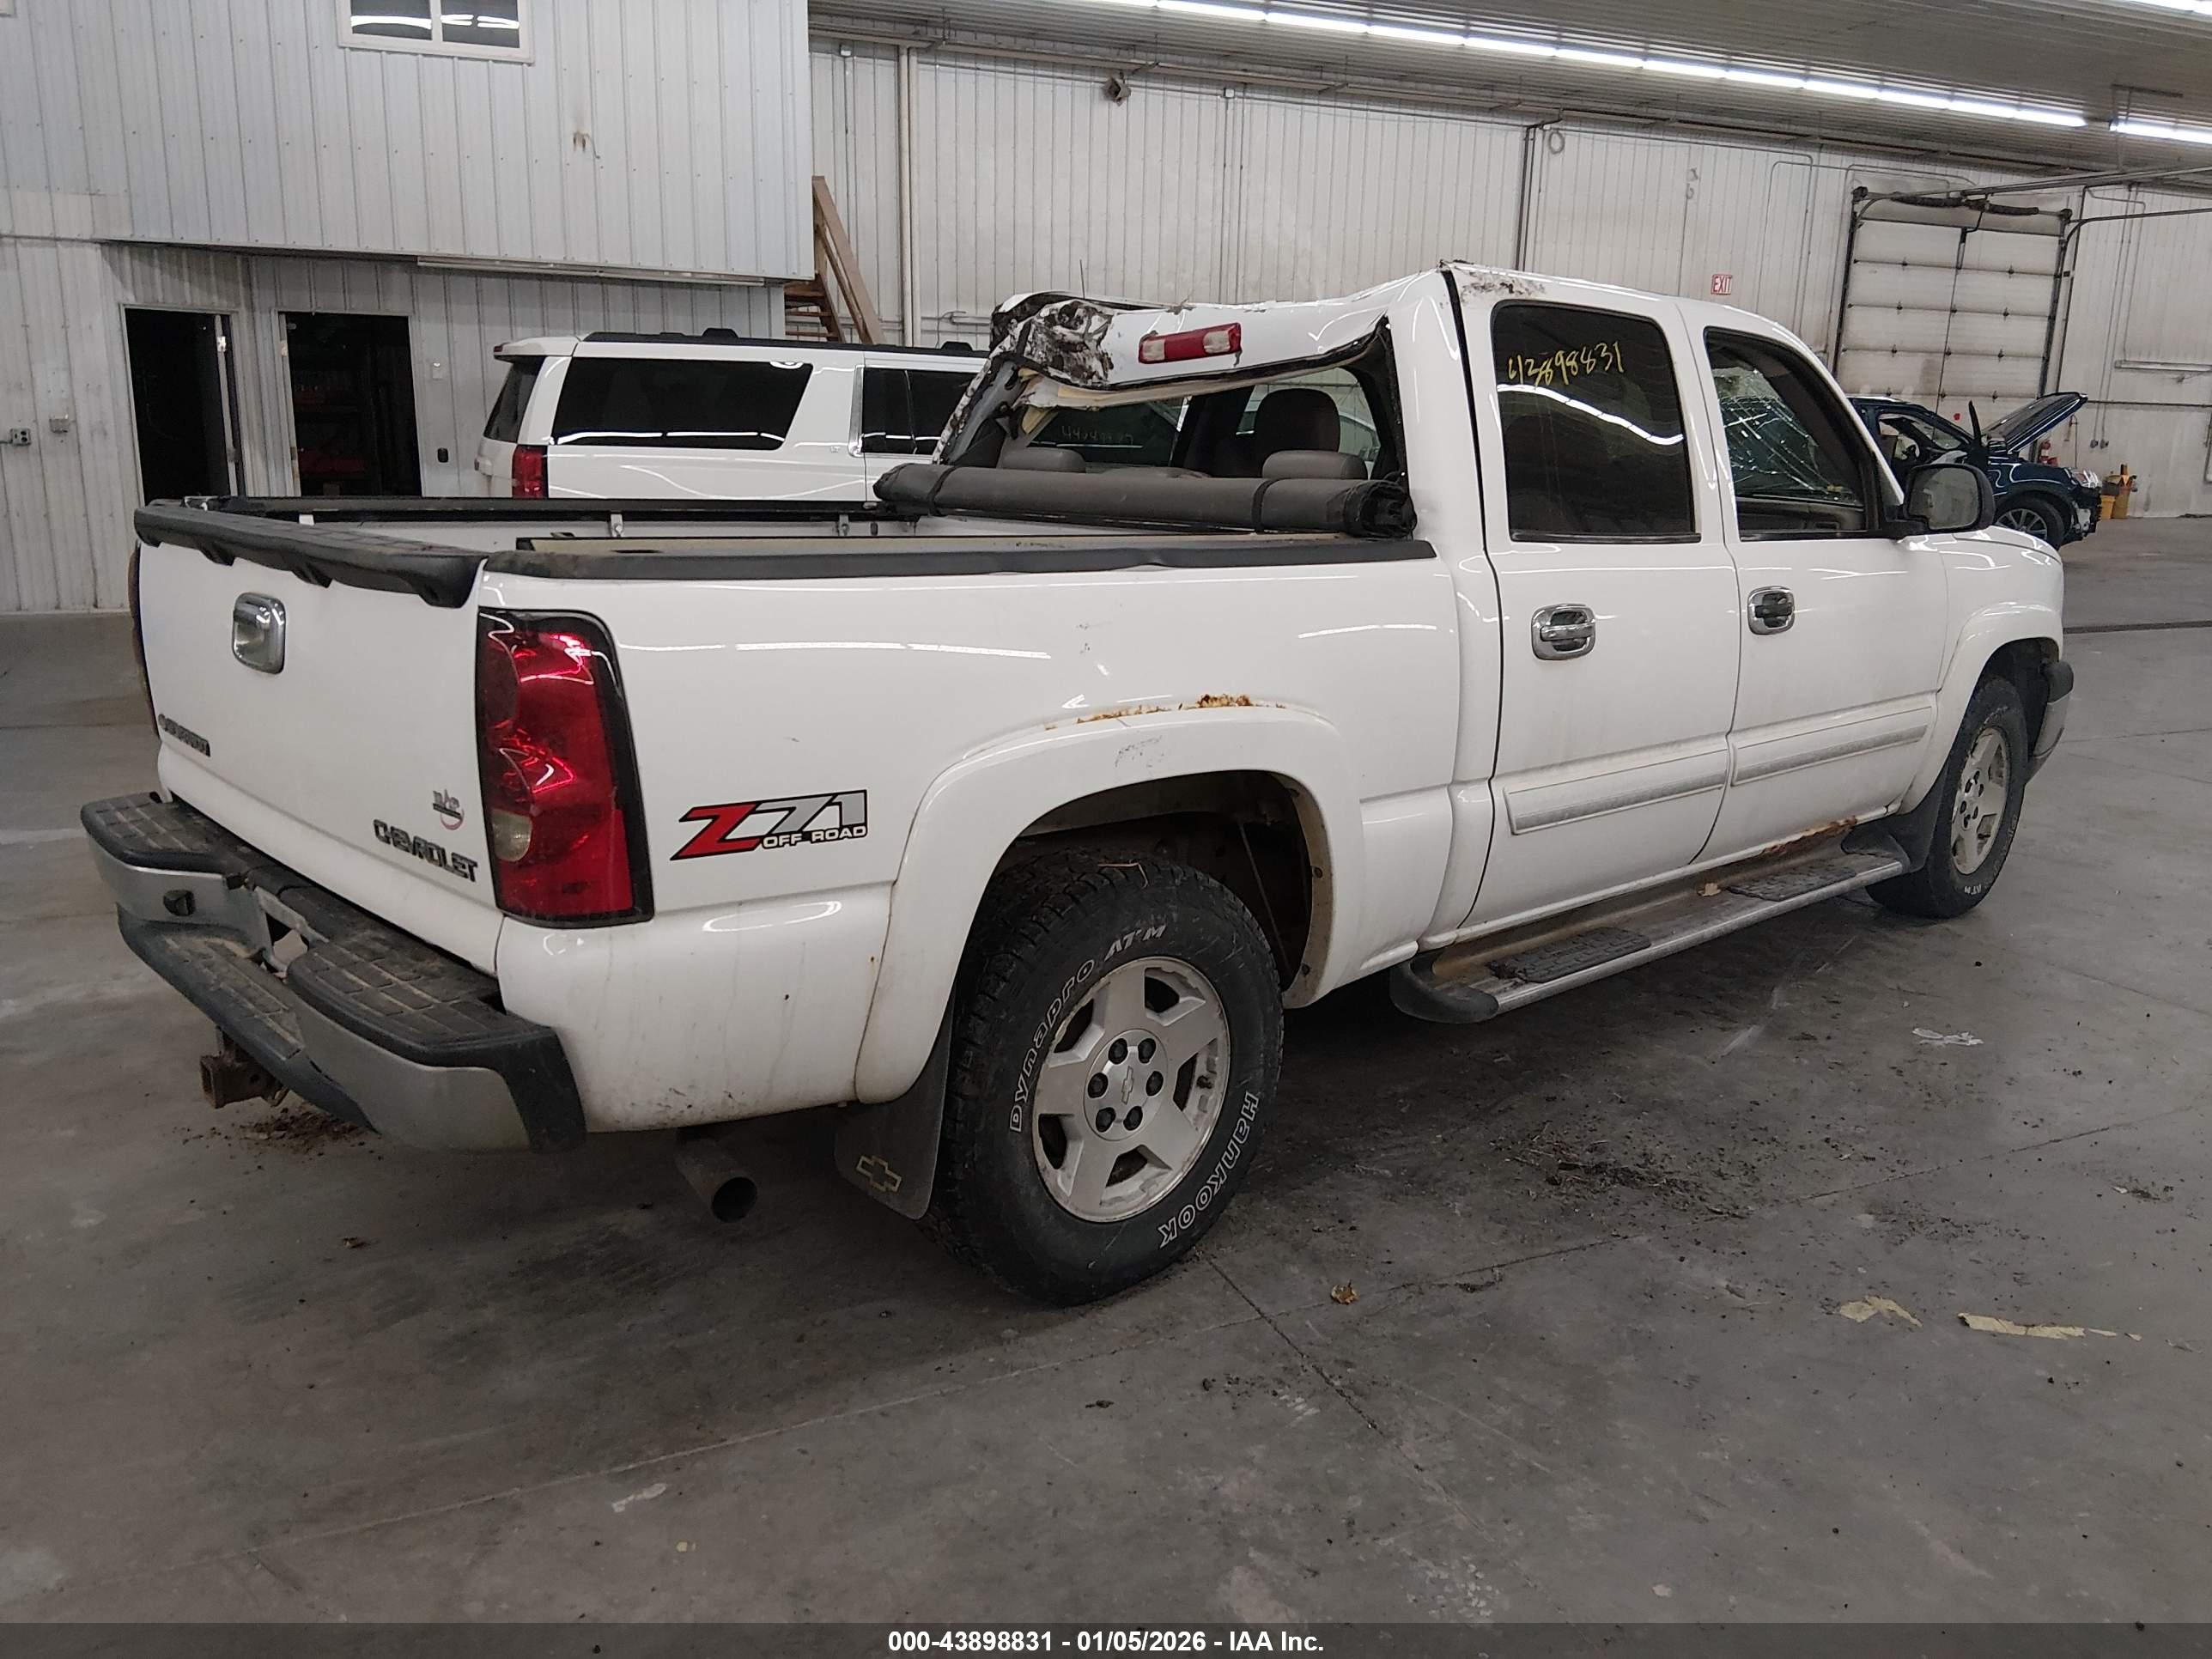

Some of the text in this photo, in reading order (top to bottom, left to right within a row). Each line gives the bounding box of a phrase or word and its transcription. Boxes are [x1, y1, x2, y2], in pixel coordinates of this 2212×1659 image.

[1713, 275, 1732, 293] EXIT
[670, 789, 867, 860] Z71
[763, 825, 866, 848] OFF ROAD
